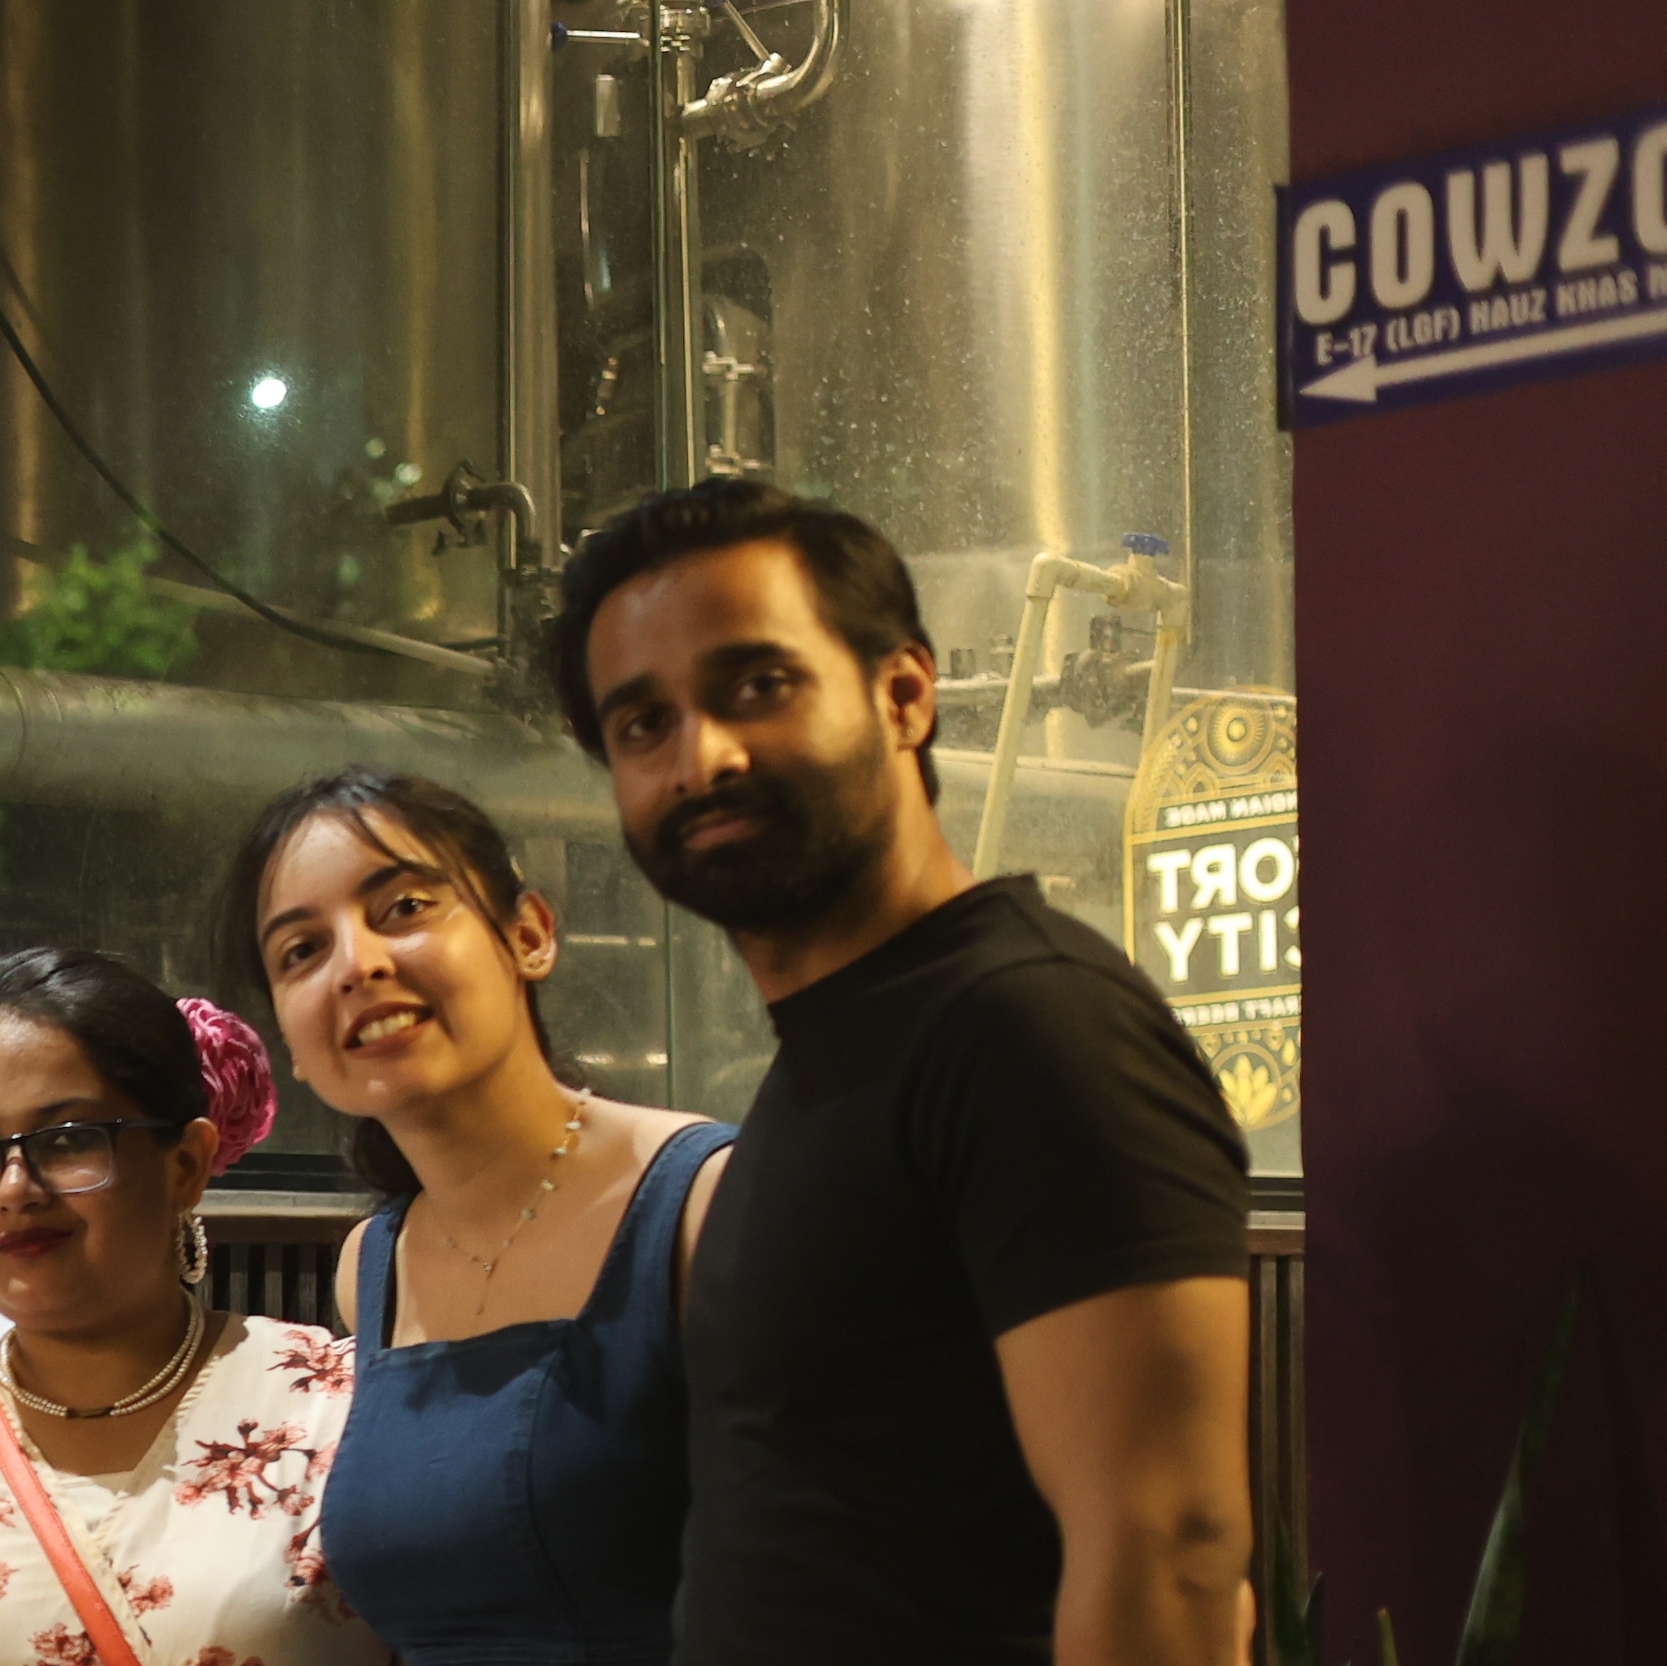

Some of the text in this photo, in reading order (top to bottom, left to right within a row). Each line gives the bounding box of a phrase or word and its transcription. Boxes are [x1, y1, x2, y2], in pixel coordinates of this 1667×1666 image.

[1317, 322, 1377, 366] E-17
[1470, 289, 1548, 335] HAUZ
[1556, 269, 1640, 317] KHAS
